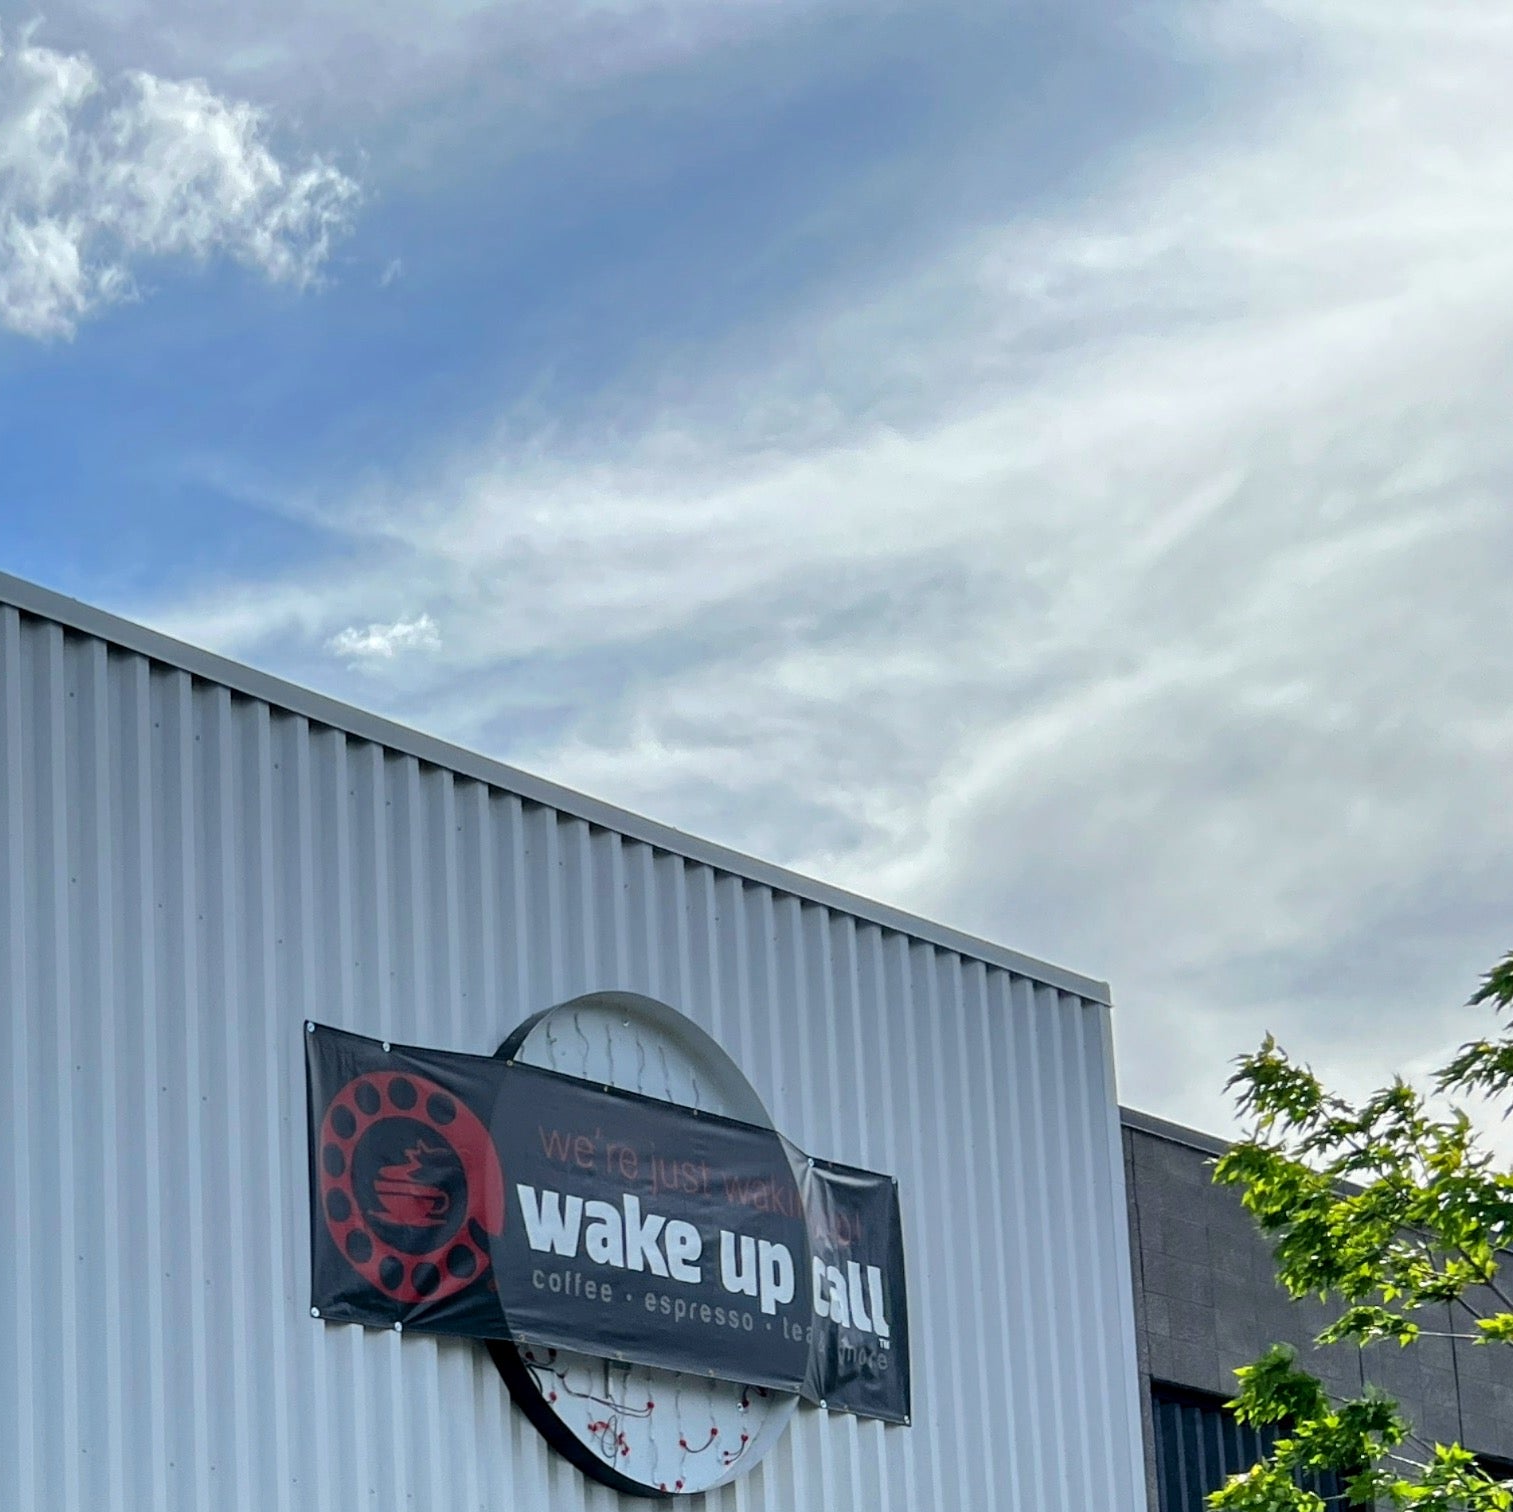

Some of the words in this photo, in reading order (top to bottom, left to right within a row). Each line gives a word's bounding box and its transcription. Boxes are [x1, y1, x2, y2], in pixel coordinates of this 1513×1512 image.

[538, 1124, 639, 1180] we're
[650, 1141, 712, 1199] just
[516, 1182, 703, 1285] wake
[719, 1229, 796, 1316] up
[812, 1255, 891, 1337] call
[531, 1267, 613, 1304] coffee
[644, 1290, 755, 1333] espresso
